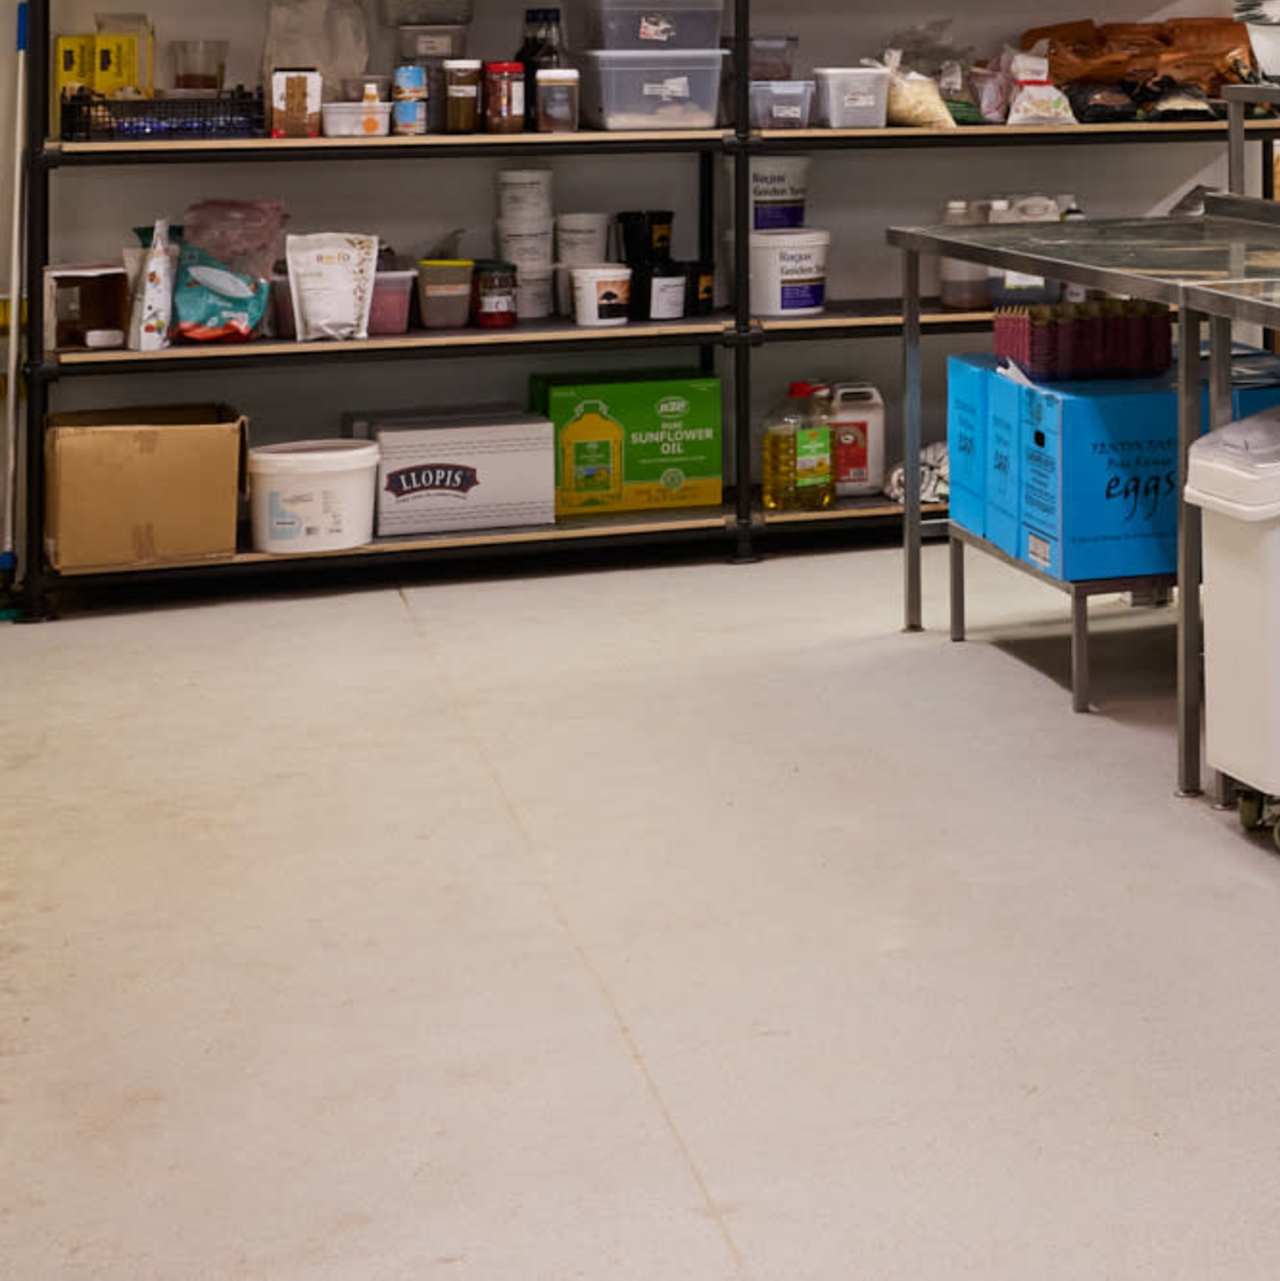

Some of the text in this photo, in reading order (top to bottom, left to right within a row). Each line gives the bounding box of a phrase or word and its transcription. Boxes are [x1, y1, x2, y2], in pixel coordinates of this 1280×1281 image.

[630, 428, 714, 444] SUNFLOWER
[660, 442, 684, 455] OIL
[399, 469, 464, 491] LLOPIS
[1104, 470, 1176, 521] eggs
